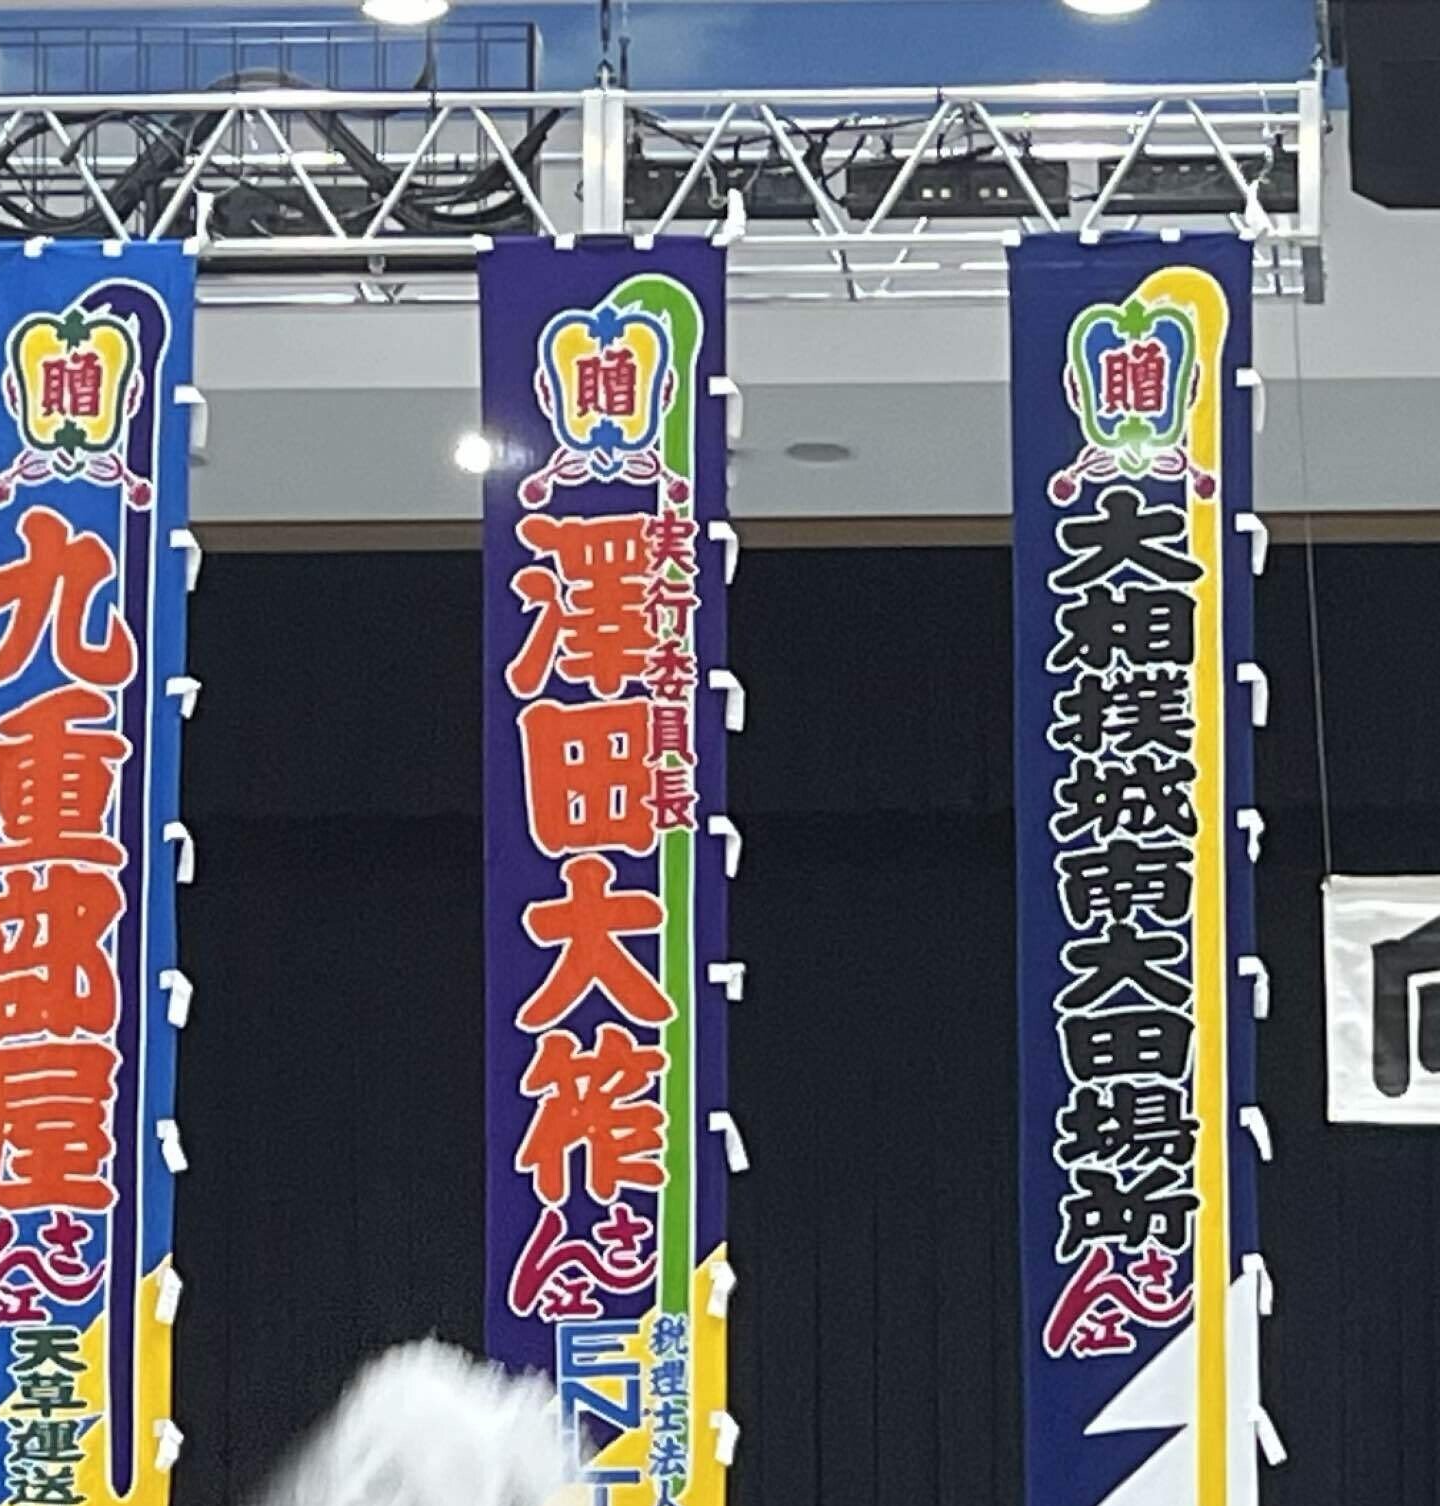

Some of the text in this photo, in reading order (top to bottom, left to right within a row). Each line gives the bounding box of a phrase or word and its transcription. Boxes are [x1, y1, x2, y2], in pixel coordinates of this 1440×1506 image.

[38, 354, 105, 418] 贈
[573, 354, 642, 421] 贈
[1099, 343, 1164, 414] 贈
[645, 512, 698, 832] 実行委員長
[1053, 492, 1205, 1252] 大相撲城南大田場所
